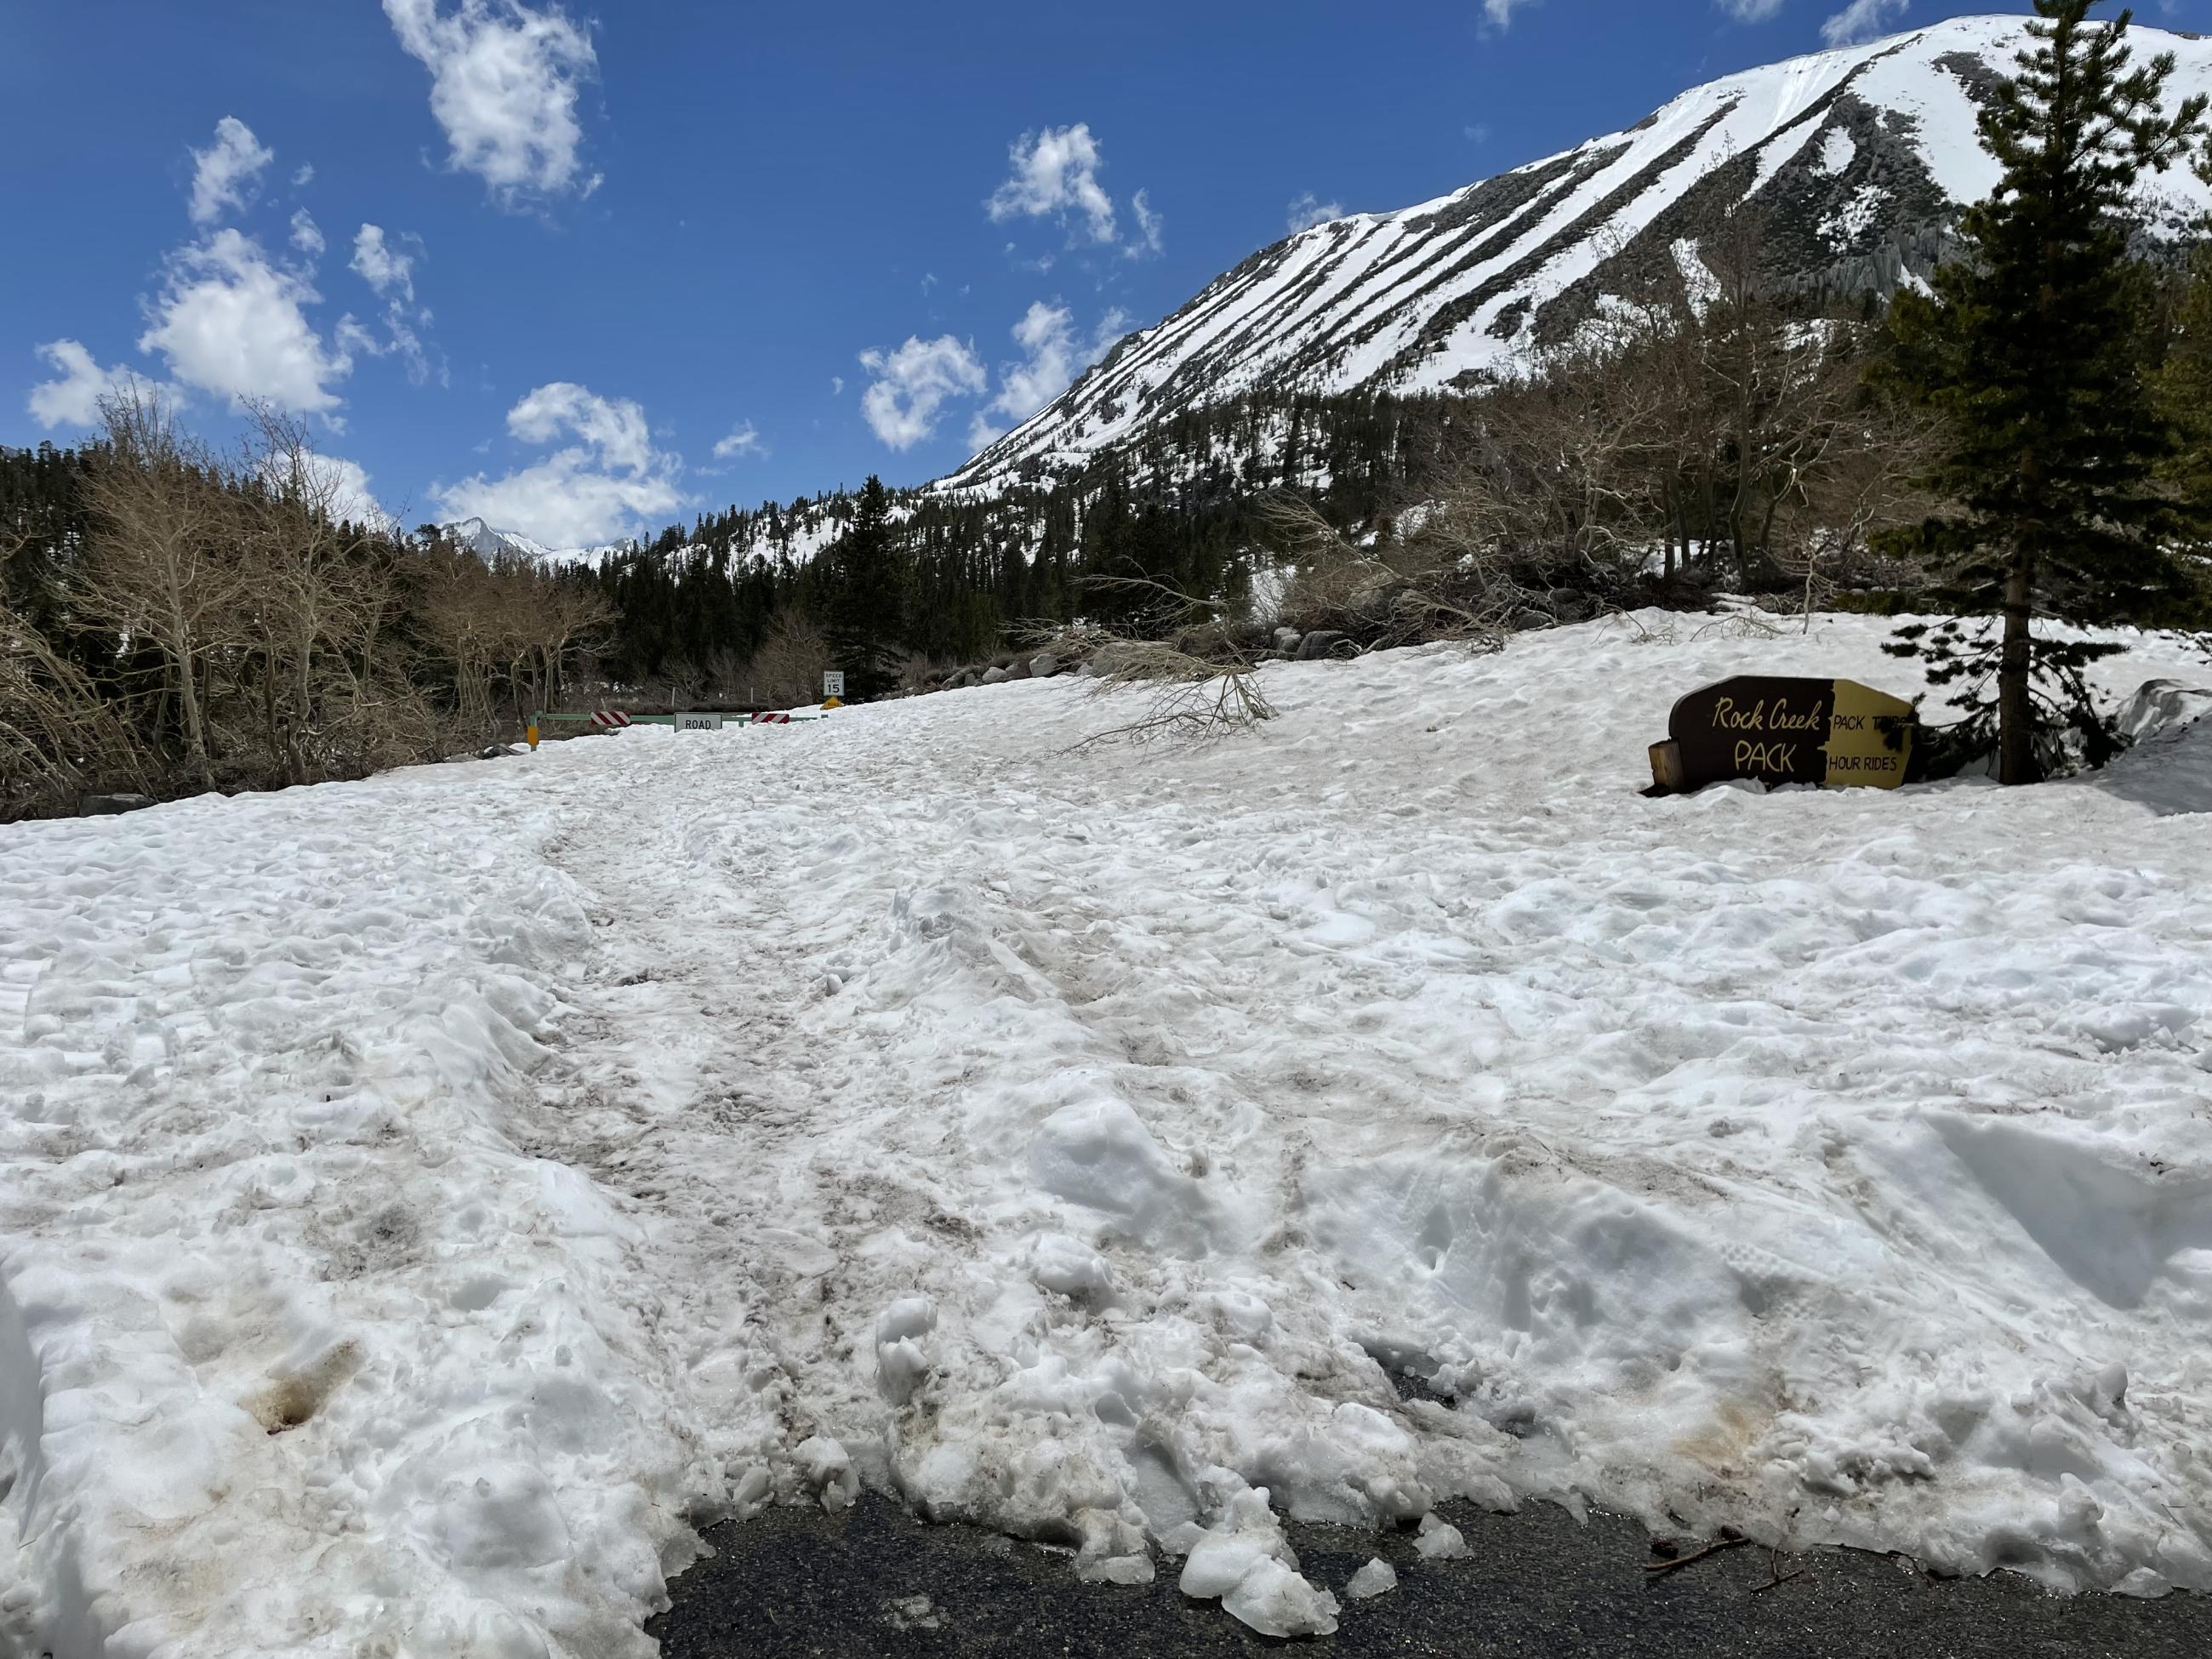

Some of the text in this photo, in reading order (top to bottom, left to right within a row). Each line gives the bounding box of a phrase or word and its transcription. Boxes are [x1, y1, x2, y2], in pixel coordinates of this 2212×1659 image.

[828, 683, 840, 693] 15
[1712, 696, 1822, 730] Rock Creek
[685, 719, 711, 730] ROAD
[1833, 715, 1866, 730] PACK
[1735, 739, 1797, 772] PACK
[1829, 756, 1897, 771] HOUR RIDES
